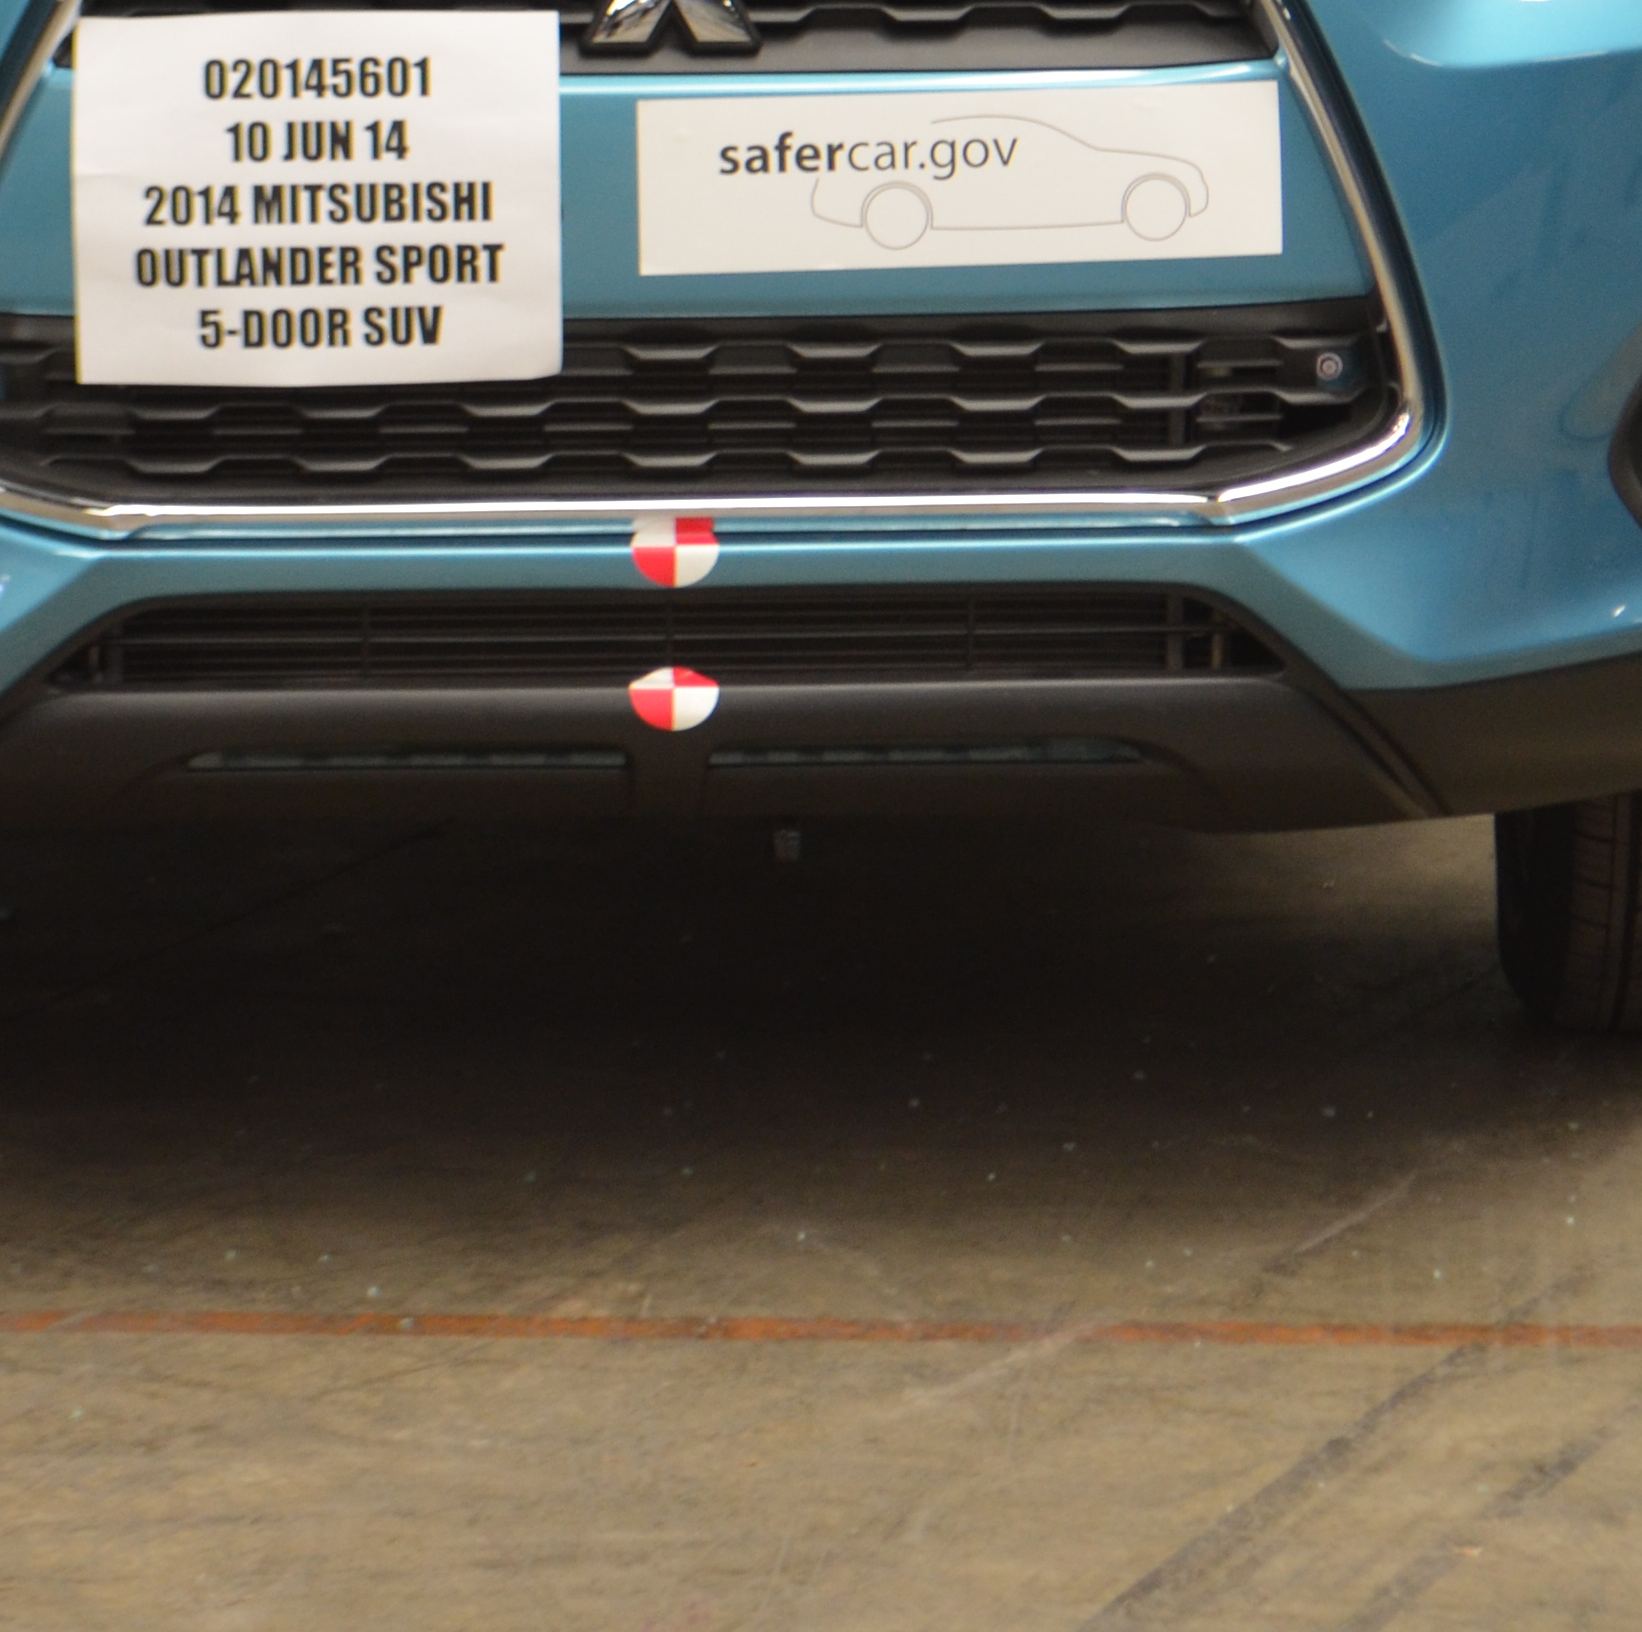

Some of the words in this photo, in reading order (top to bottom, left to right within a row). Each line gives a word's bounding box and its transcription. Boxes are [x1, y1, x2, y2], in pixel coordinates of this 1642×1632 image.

[203, 57, 430, 100] 020145601
[225, 121, 270, 163] 10
[282, 120, 353, 162] JUN
[364, 120, 409, 161] 14
[718, 130, 1019, 181] safercar.gov
[143, 185, 241, 226] 2014
[252, 181, 494, 225] MITSUBISHI
[134, 245, 361, 288] OUTLANDER
[374, 243, 506, 285] SPORT
[199, 308, 350, 349] 5-DOOR
[362, 305, 444, 347] SUV
